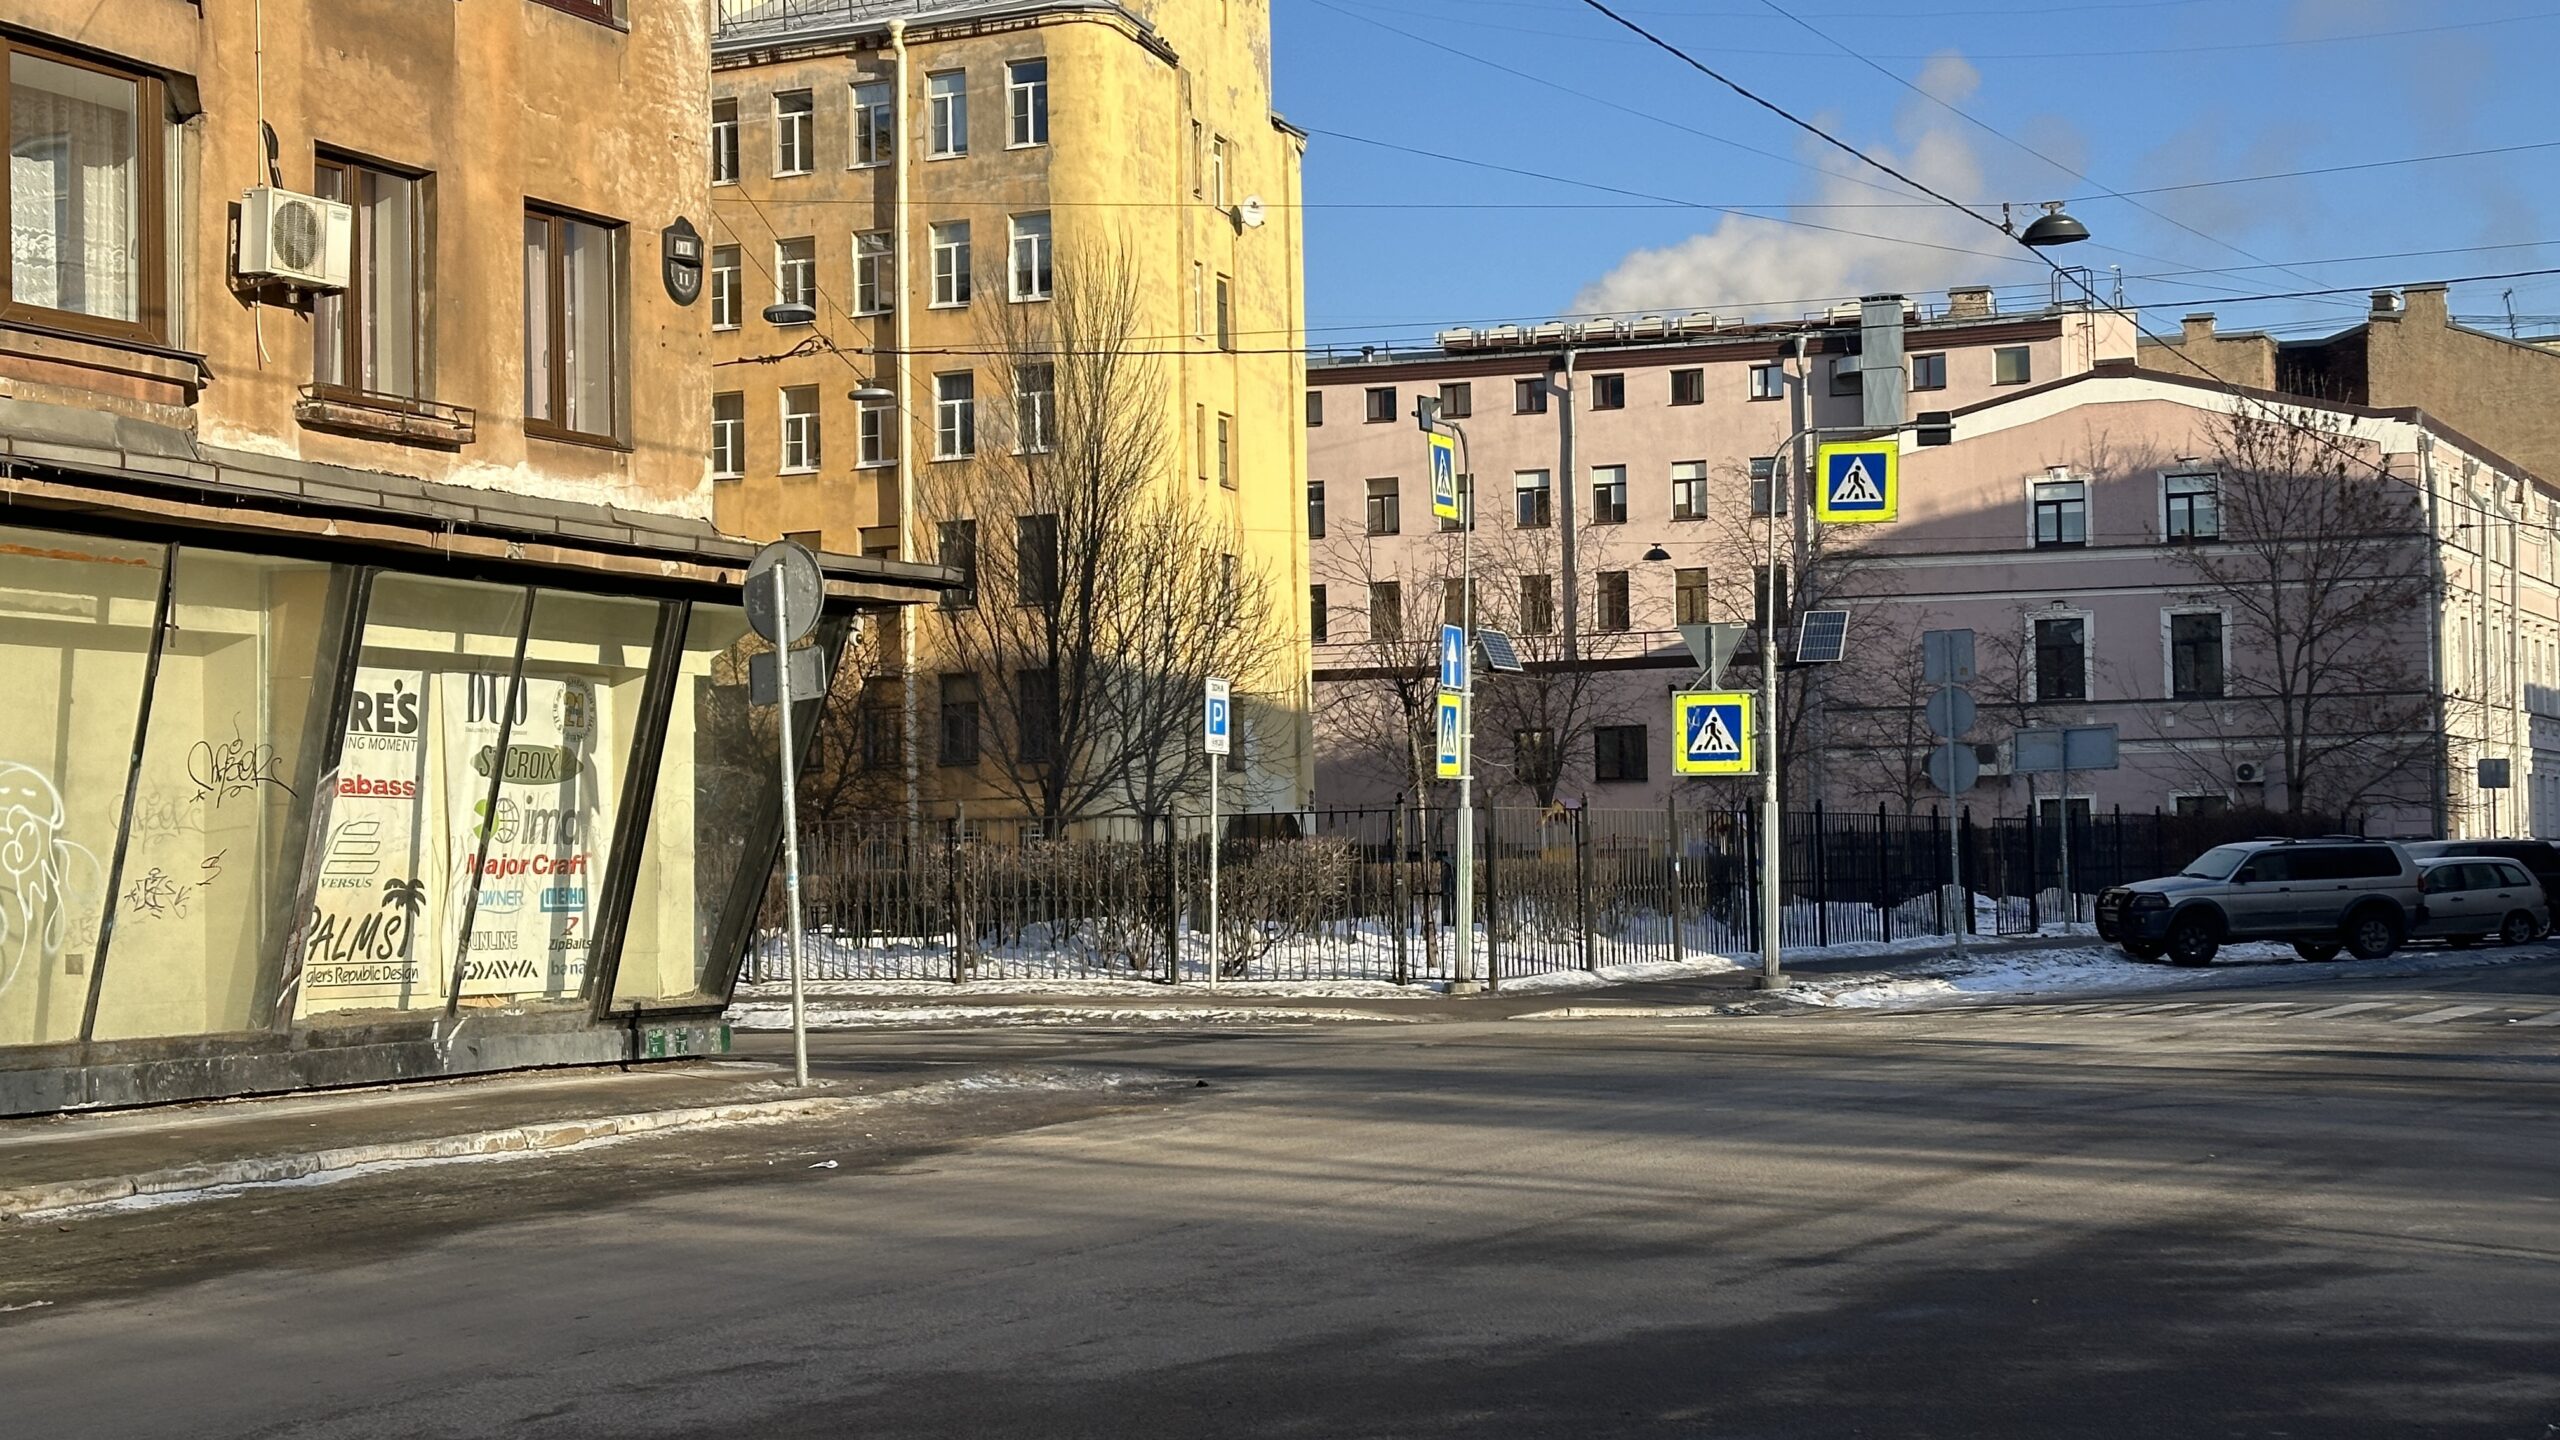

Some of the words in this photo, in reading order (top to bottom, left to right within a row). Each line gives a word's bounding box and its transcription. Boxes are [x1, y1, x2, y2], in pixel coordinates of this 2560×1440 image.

[1213, 702, 1224, 732] P
[368, 738, 418, 752] MOMENT
[505, 747, 559, 780] CROIX
[532, 854, 587, 875] Craft
[320, 878, 373, 889] VERSUS
[471, 931, 519, 951] UNLINE
[548, 938, 592, 952] ZipBaits
[335, 966, 380, 985] Republic
[383, 965, 418, 983] Design
